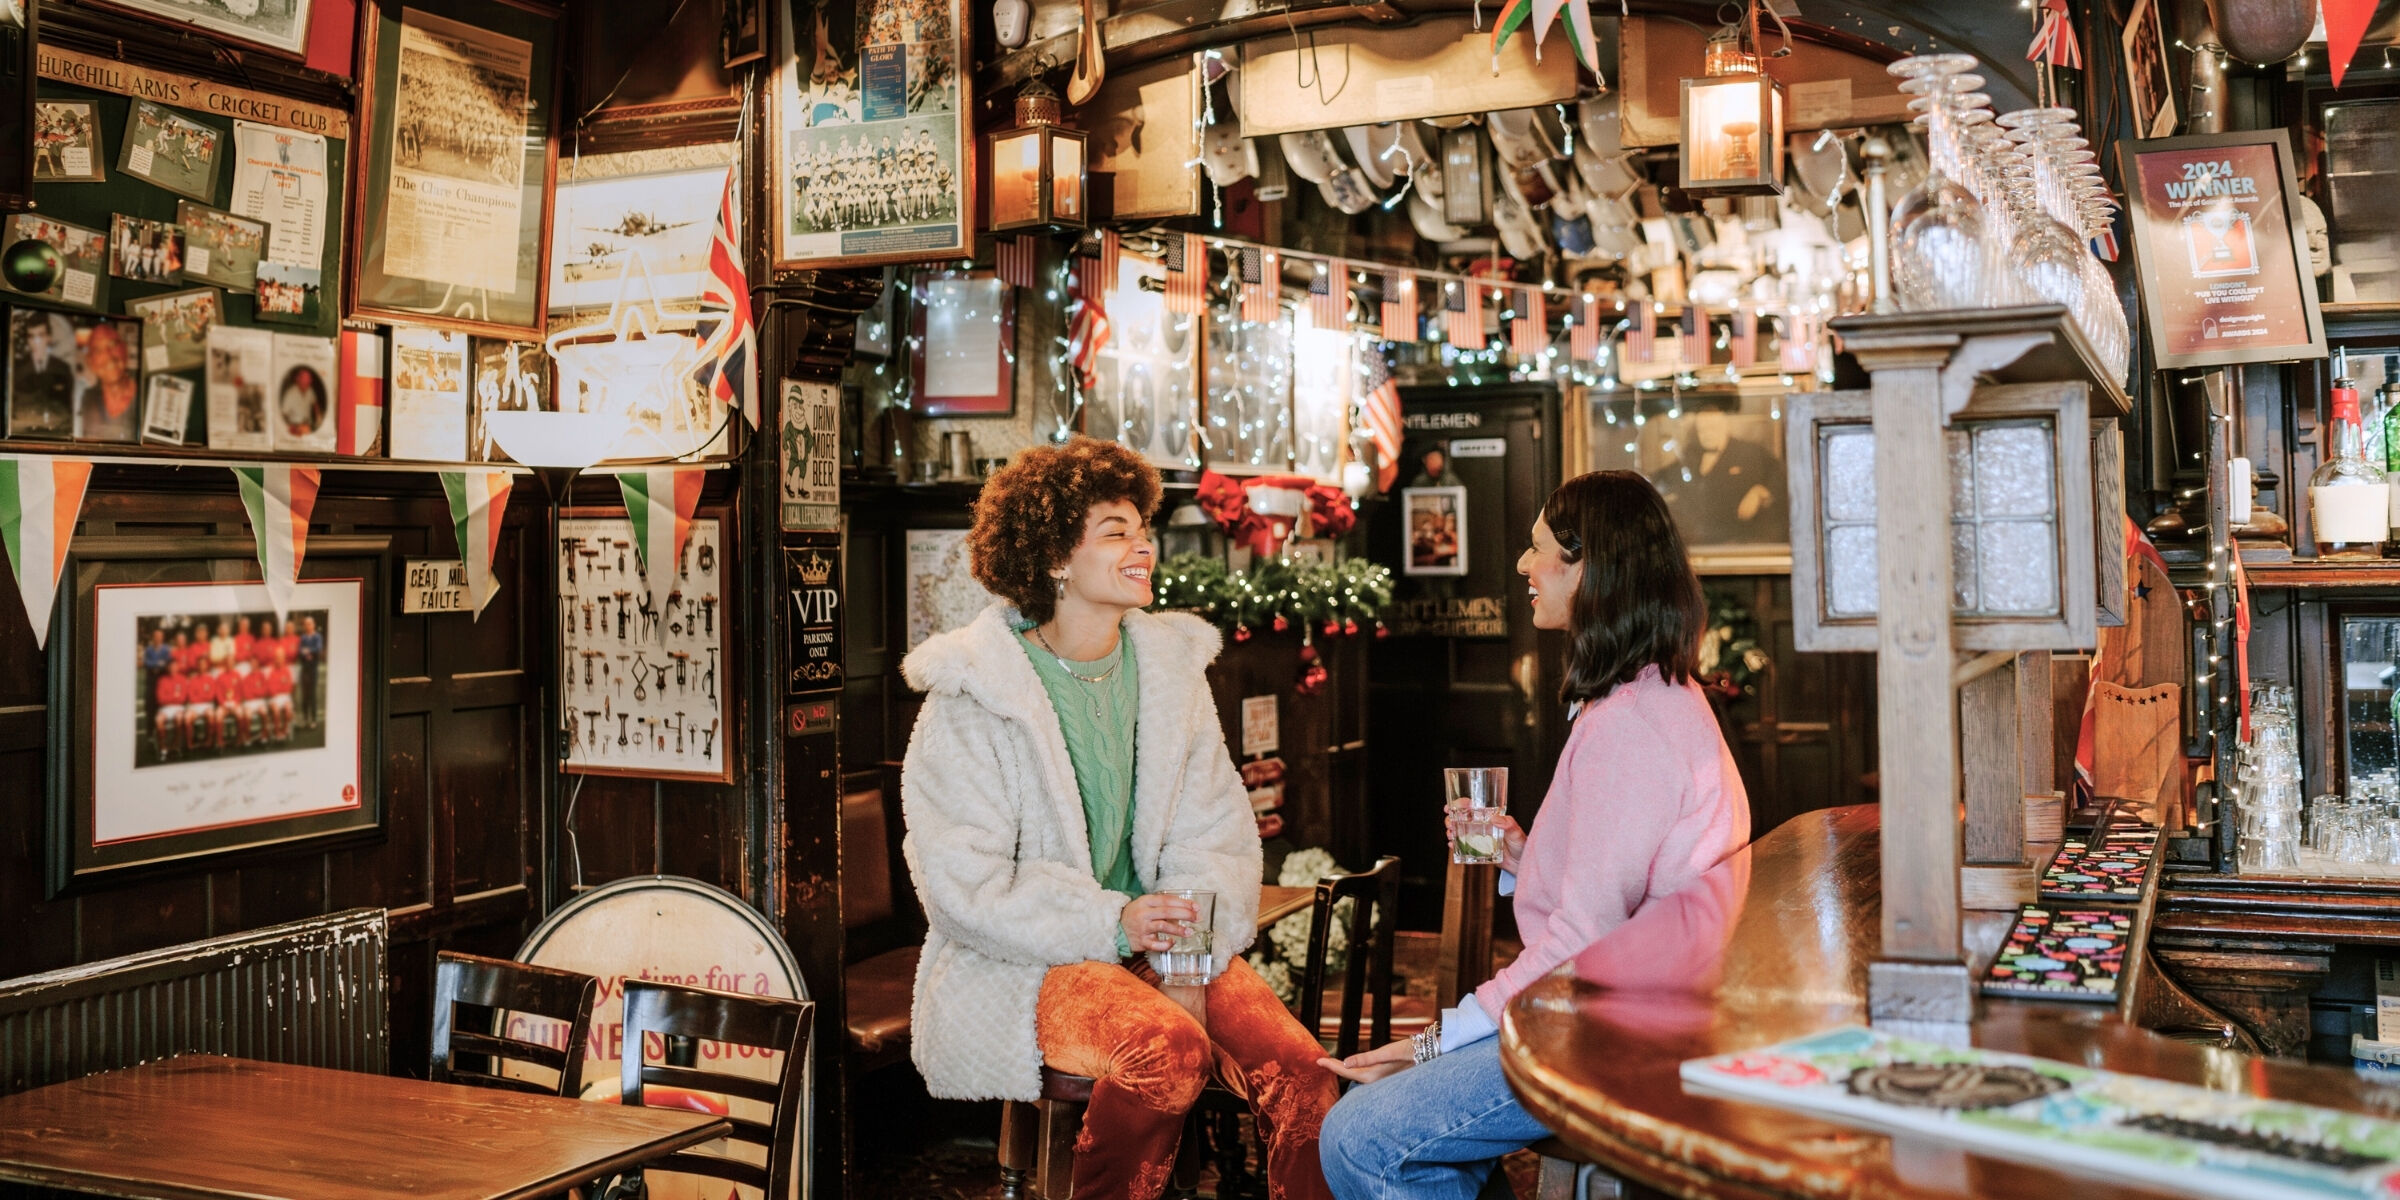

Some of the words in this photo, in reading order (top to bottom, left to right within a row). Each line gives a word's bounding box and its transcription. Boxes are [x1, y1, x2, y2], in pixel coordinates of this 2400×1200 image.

[869, 47, 886, 55] PATH
[870, 54, 894, 62] GLORY
[38, 54, 124, 90] HURCHILL
[132, 75, 180, 101] ARMS
[208, 92, 282, 122] CRICKET
[290, 109, 327, 131] CLUB
[247, 158, 273, 168] Churchill
[290, 165, 310, 174] Cricket
[2182, 160, 2234, 180] 2024
[394, 175, 416, 192] The
[421, 180, 452, 199] Clare
[456, 187, 517, 209] Champions
[2164, 177, 2257, 200] WINNER
[2193, 199, 2201, 207] of
[2234, 196, 2259, 204] Awards
[2213, 289, 2228, 297] YOU
[813, 404, 836, 432] DRINK
[1401, 412, 1481, 430] NTLEMEN
[812, 433, 836, 460] MORE
[812, 460, 836, 487] BEER.
[785, 505, 801, 525] LOCAL
[410, 563, 439, 588] CÉAD
[448, 563, 469, 586] MÍL
[791, 589, 838, 624] VIP
[803, 632, 833, 645] PARKING
[809, 646, 828, 658] ONLY
[812, 705, 826, 718] NO
[705, 965, 747, 992] for
[753, 972, 772, 998] a
[506, 1017, 666, 1061] GUINES
